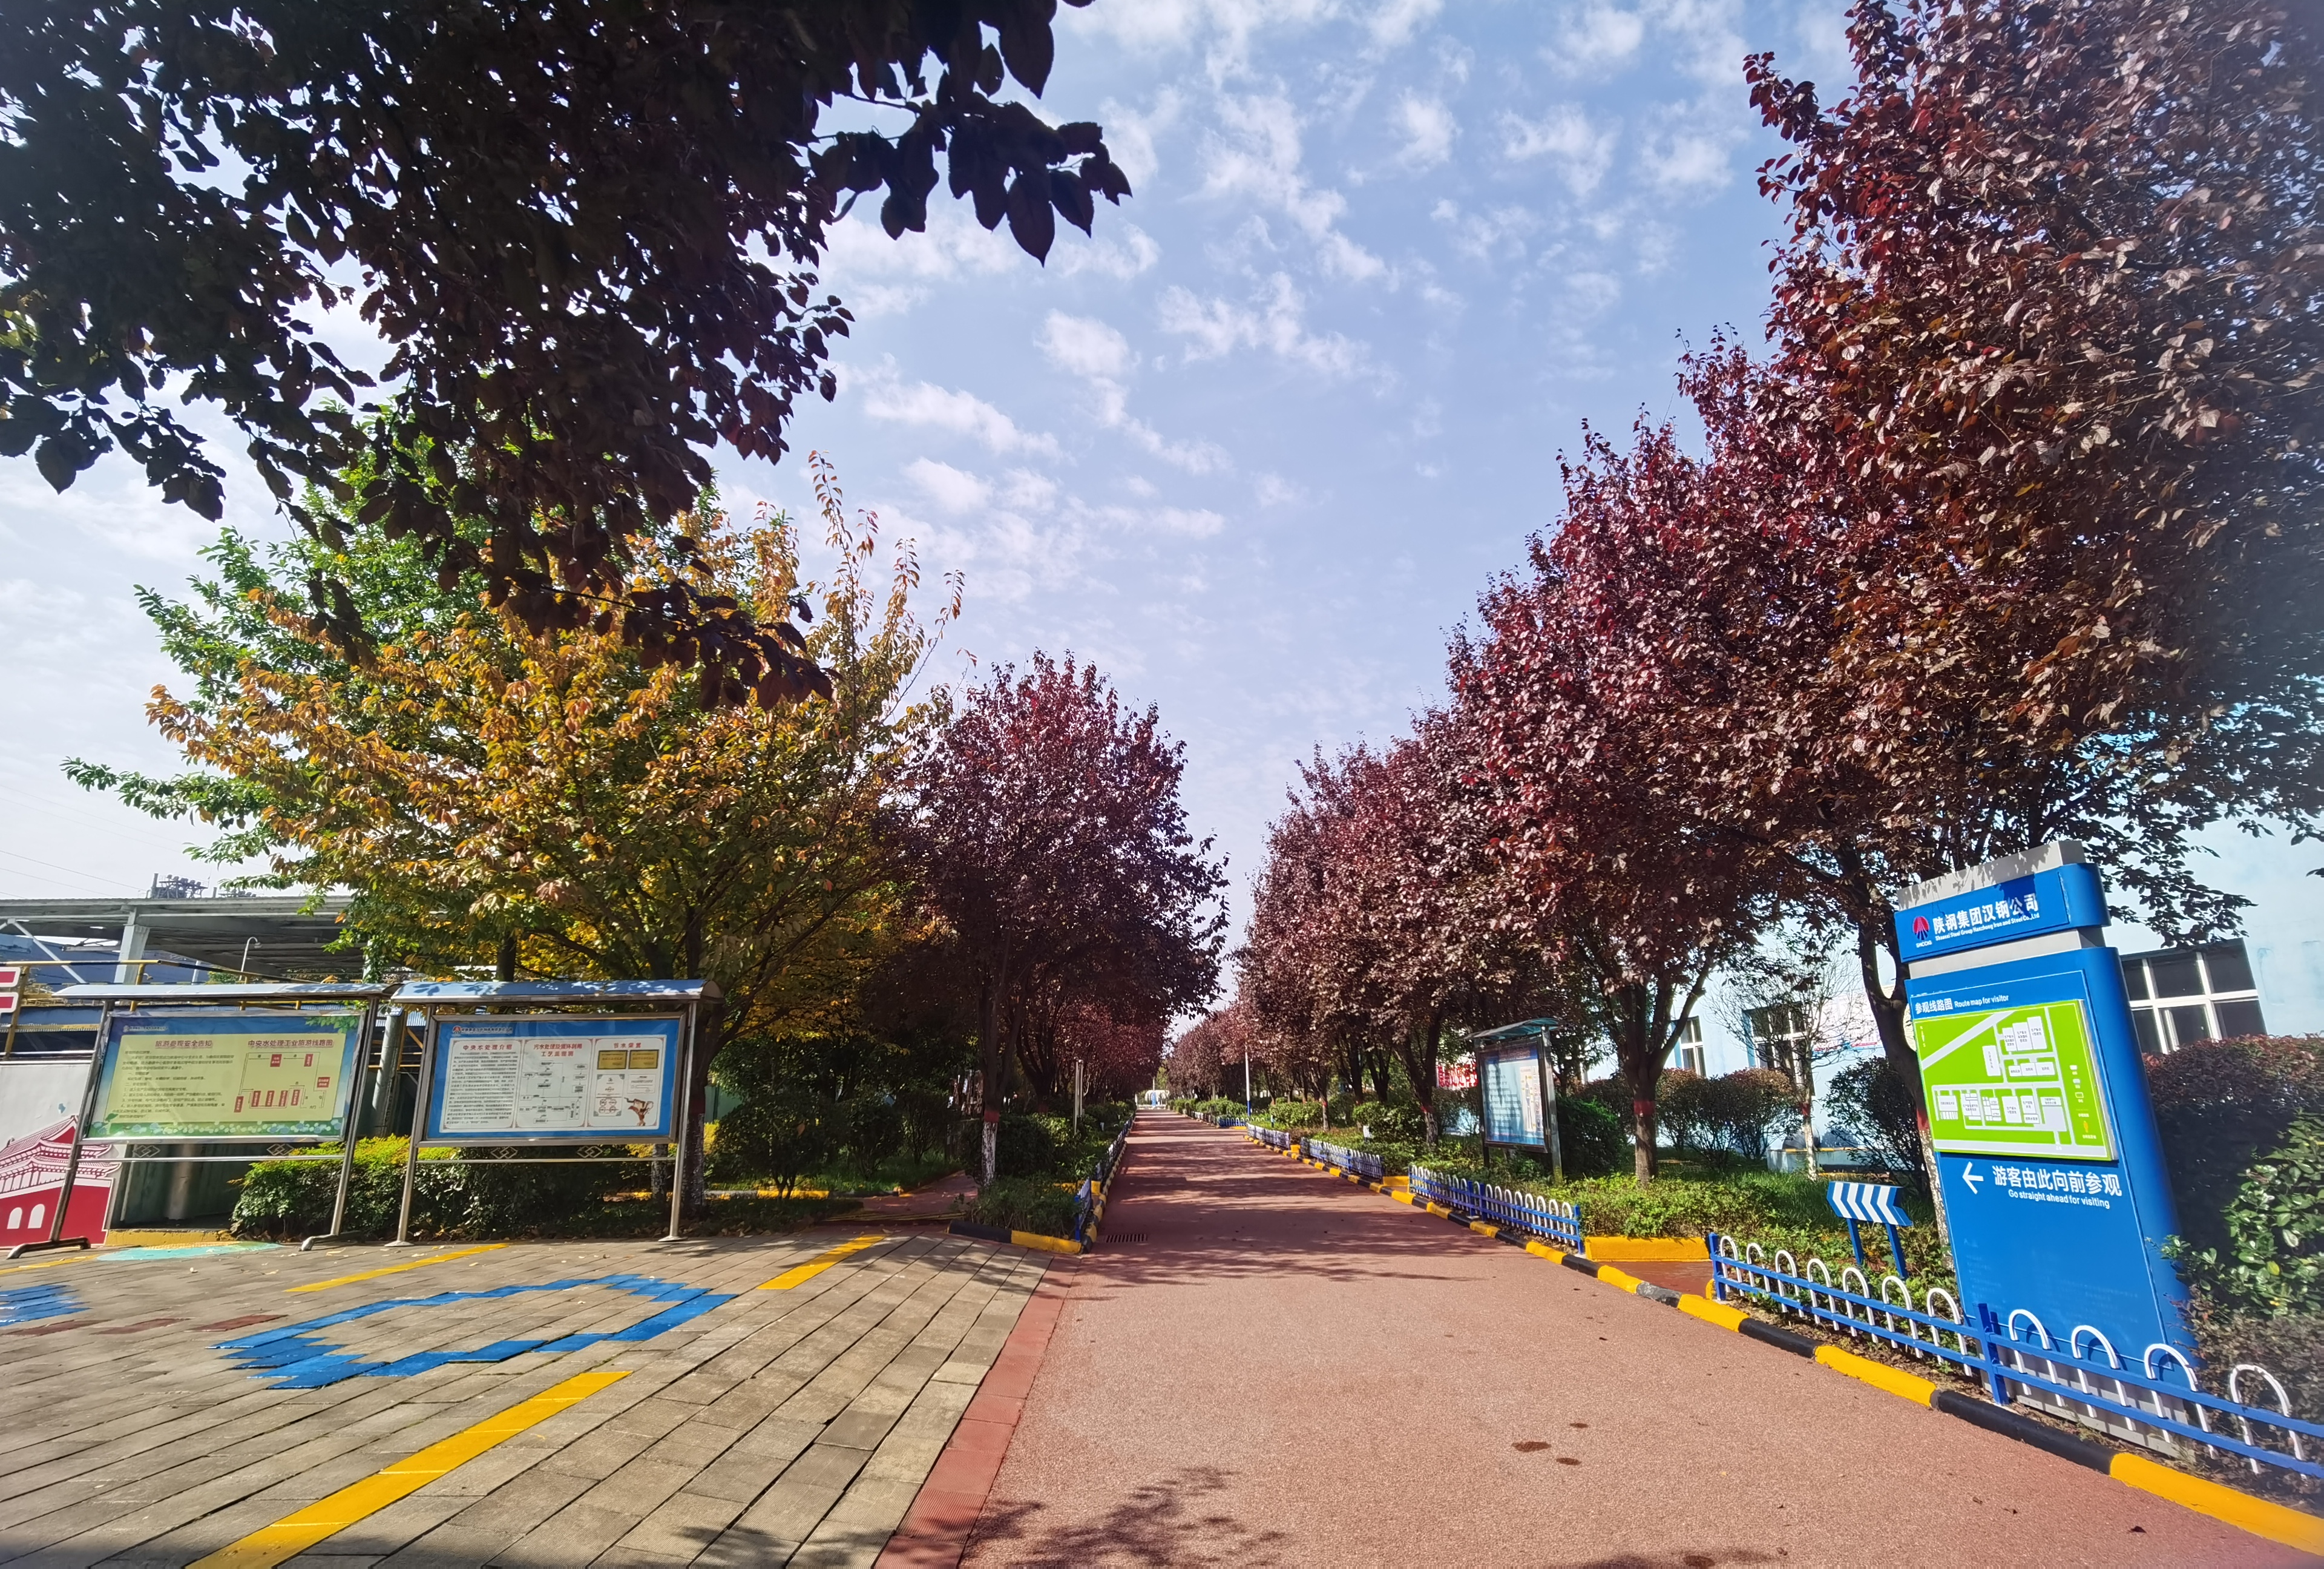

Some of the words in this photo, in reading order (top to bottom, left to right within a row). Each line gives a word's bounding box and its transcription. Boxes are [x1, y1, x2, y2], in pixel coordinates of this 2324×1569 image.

[1932, 893, 2039, 935] 陕钢集团汉钢公司
[1972, 923, 1994, 933] Hanzhong
[1915, 998, 1954, 1015] 参观线路图
[1991, 995, 2009, 1003] visitor
[1992, 1165, 2122, 1197] 游客由此向前参观
[2008, 1189, 2018, 1198] Go
[2019, 1190, 2046, 1202] straight
[2046, 1193, 2068, 1203] ahead
[2068, 1196, 2080, 1205] for
[2081, 1197, 2110, 1209] visiting
